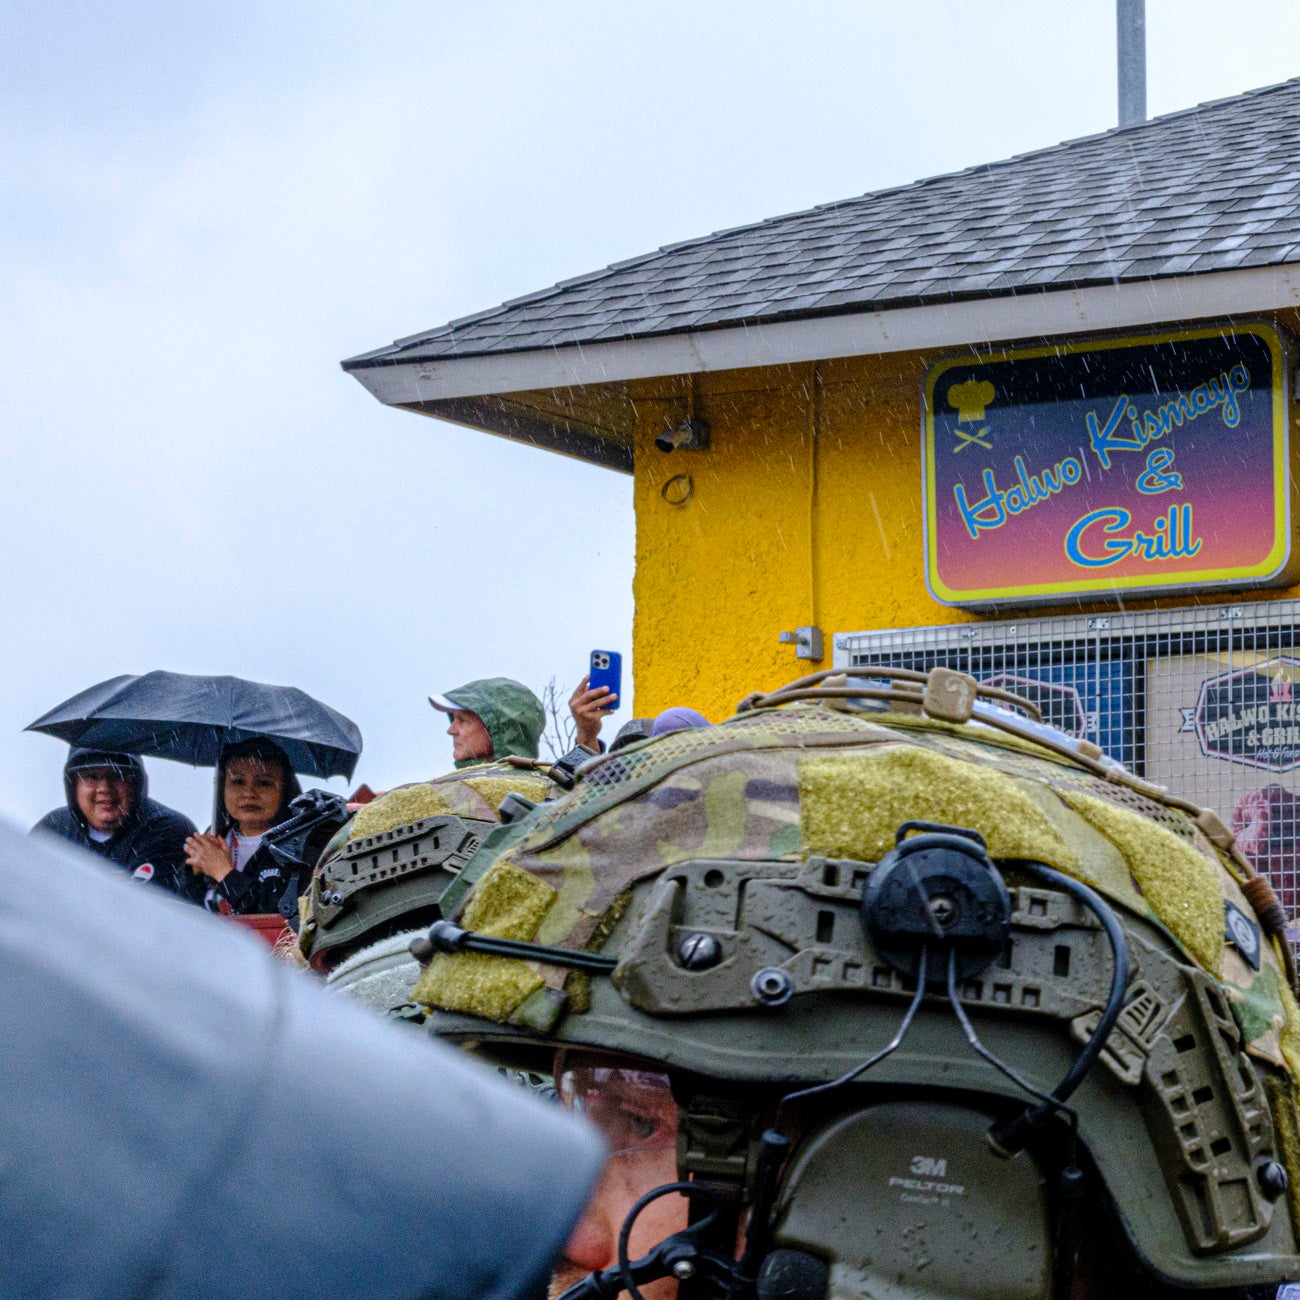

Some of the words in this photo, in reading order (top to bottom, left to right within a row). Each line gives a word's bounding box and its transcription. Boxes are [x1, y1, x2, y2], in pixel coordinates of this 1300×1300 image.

[953, 455, 1082, 539] Halwo
[1086, 363, 1251, 469] Kismayo
[1135, 447, 1184, 494] &
[1064, 502, 1202, 569] Grill
[1205, 705, 1270, 742] HALWO
[889, 1177, 965, 1194] PELTOR
[910, 1155, 947, 1177] 3M
